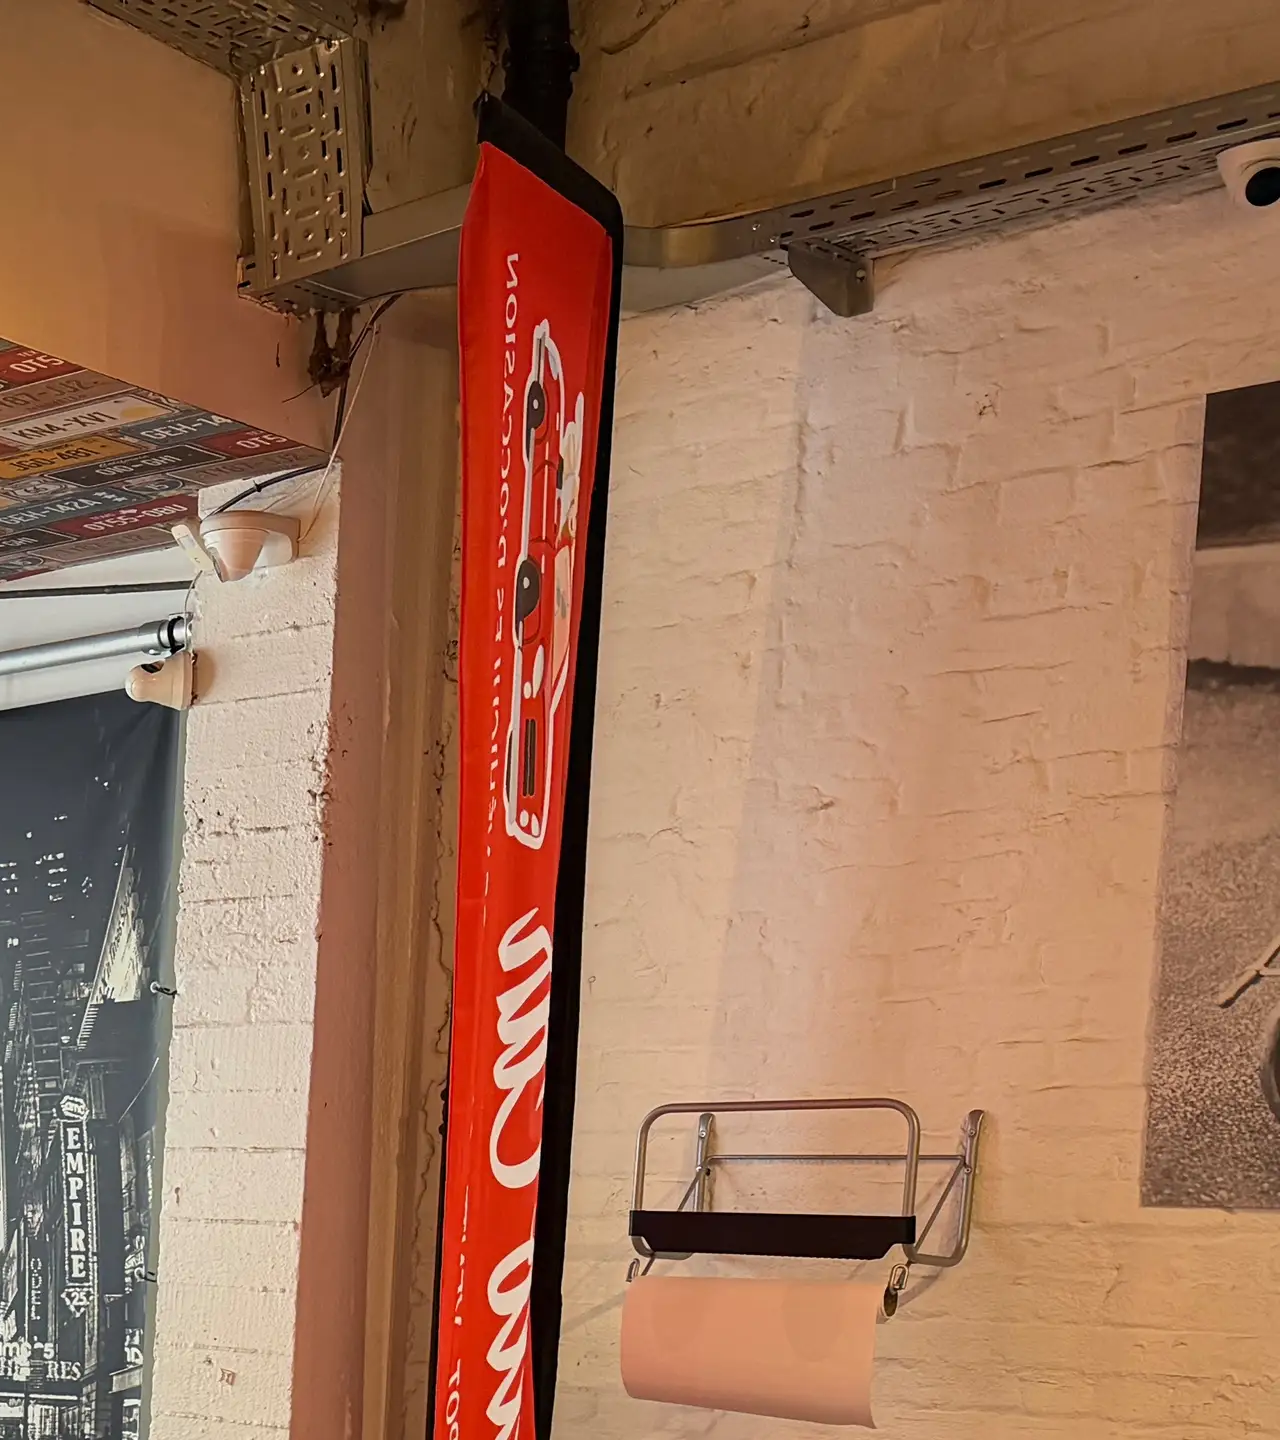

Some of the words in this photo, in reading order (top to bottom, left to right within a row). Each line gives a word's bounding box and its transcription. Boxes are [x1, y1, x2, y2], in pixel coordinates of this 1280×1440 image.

[12, 412, 118, 440] KN4-XV1
[140, 415, 234, 441] GEH-14
[65, 1127, 88, 1278] EMPIRE
